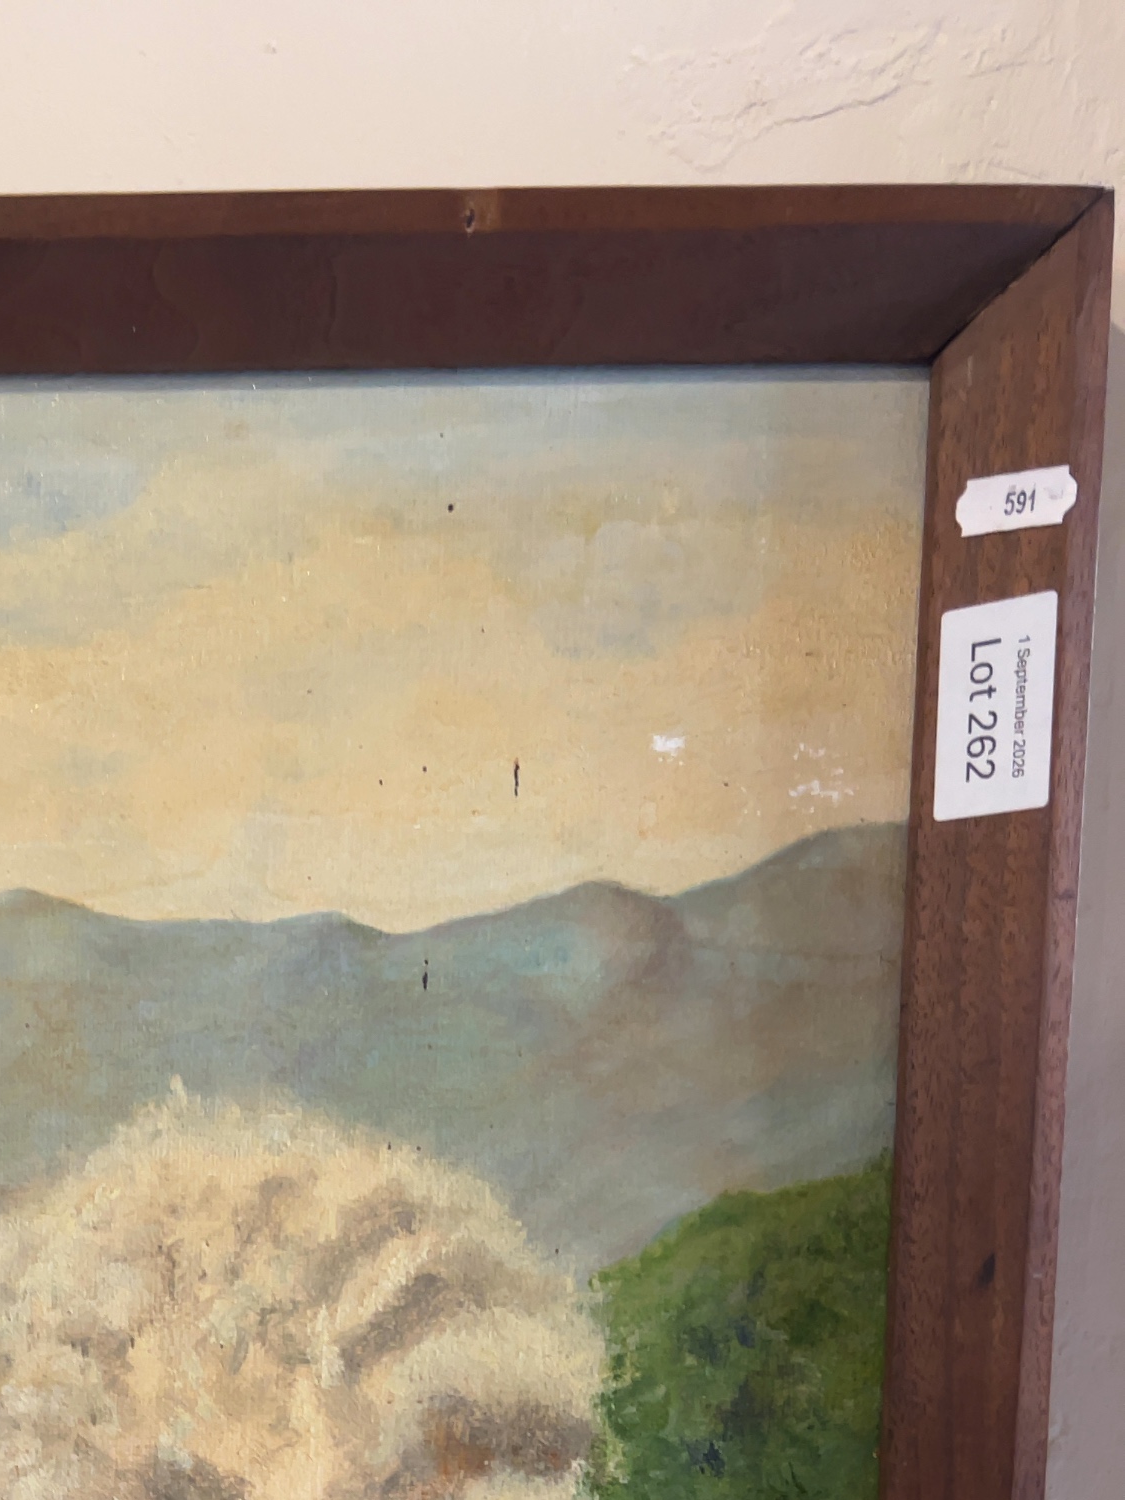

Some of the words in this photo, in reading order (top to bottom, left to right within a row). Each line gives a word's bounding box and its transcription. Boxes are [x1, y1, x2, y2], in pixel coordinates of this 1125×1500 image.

[1004, 488, 1036, 517] 591
[969, 637, 1002, 702] Lot
[1013, 648, 1031, 738] September
[965, 711, 998, 783] 262
[1011, 739, 1026, 779] 2026
